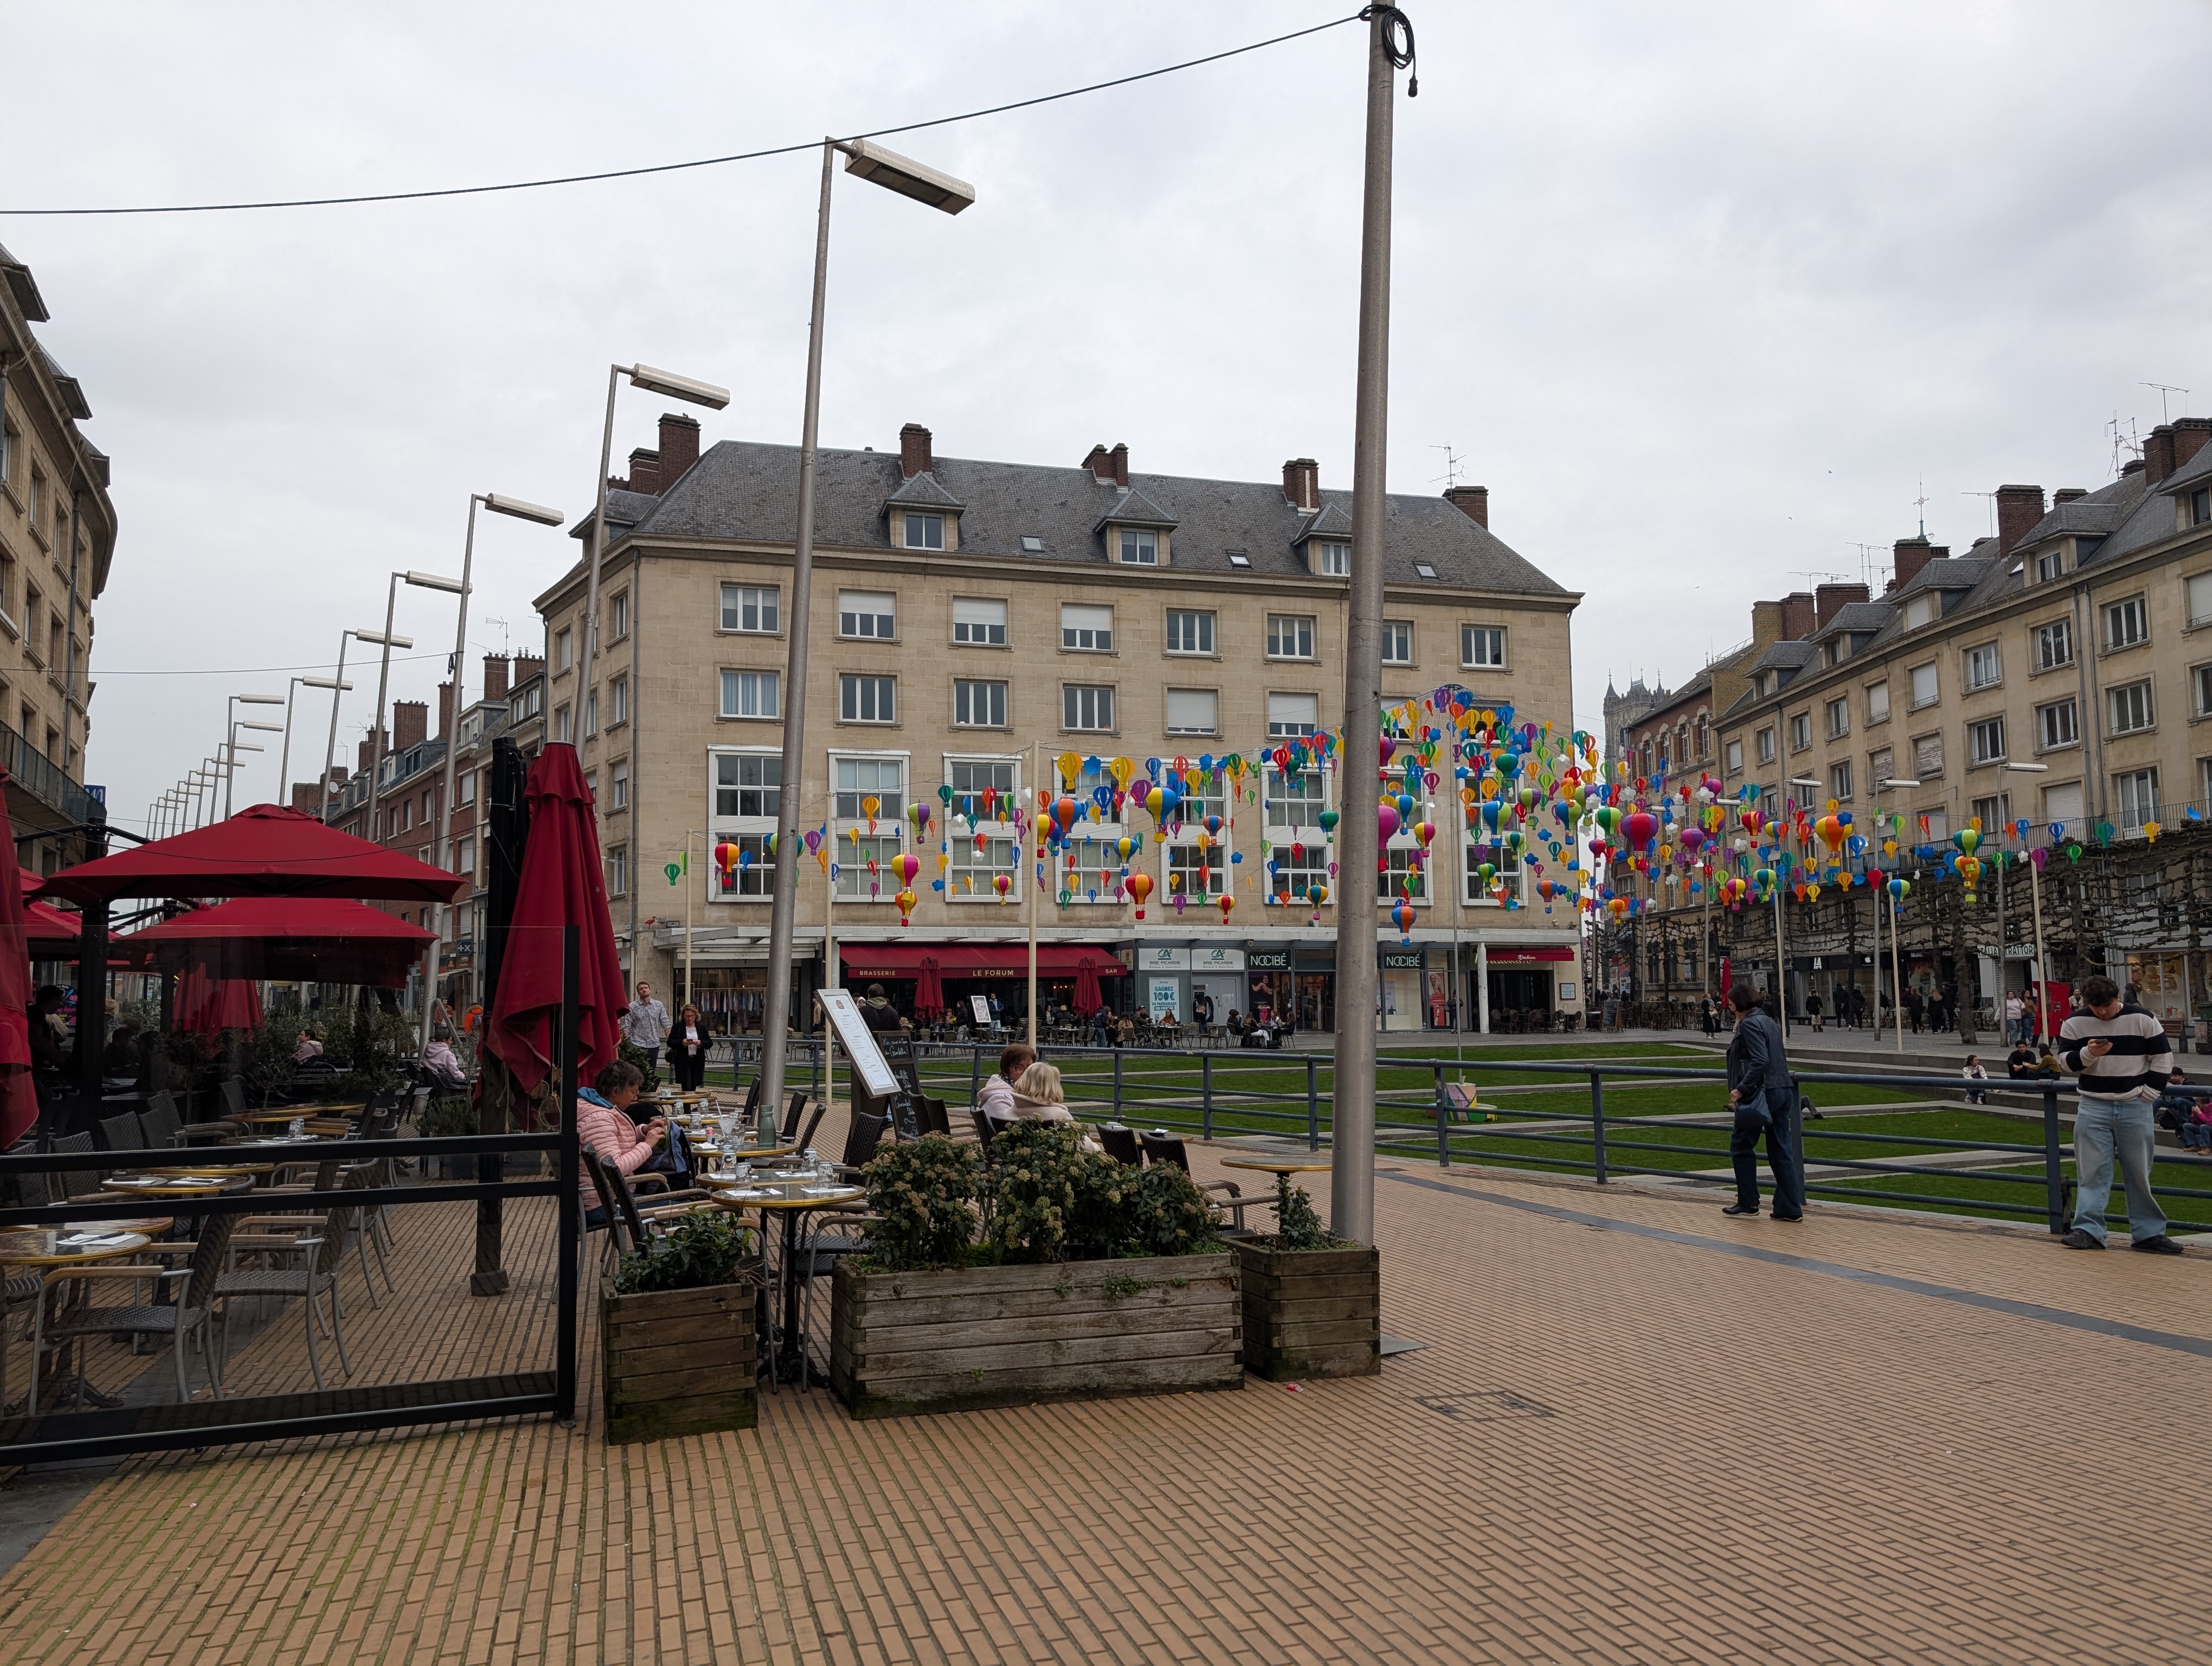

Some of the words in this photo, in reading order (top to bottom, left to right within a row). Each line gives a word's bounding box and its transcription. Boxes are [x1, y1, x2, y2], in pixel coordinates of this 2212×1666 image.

[1250, 952, 1287, 966] NOCIBÉ
[1386, 953, 1420, 966] NOCIBÉ
[1153, 992, 1175, 1001] 100€
